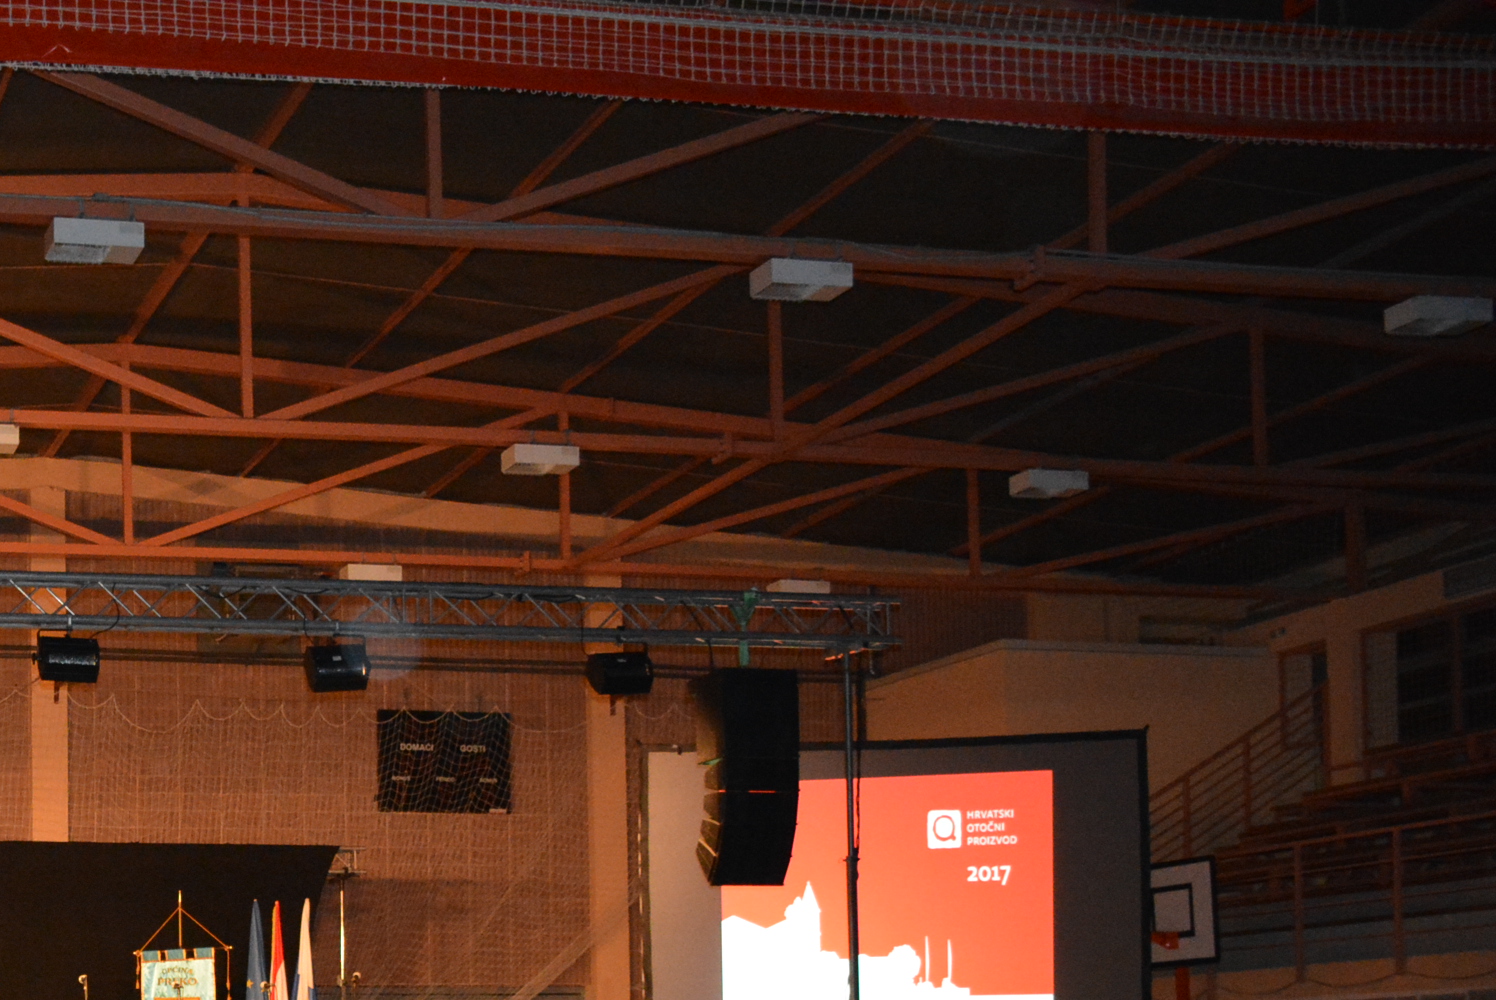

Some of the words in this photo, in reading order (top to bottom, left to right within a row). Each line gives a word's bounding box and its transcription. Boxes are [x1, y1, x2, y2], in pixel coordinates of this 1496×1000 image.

[460, 744, 486, 753] GOSTI
[966, 809, 1014, 820] HRVATSKI
[966, 821, 1005, 833] OTOČNI
[966, 835, 1018, 846] PROIZVOD
[966, 865, 1011, 886] 2017
